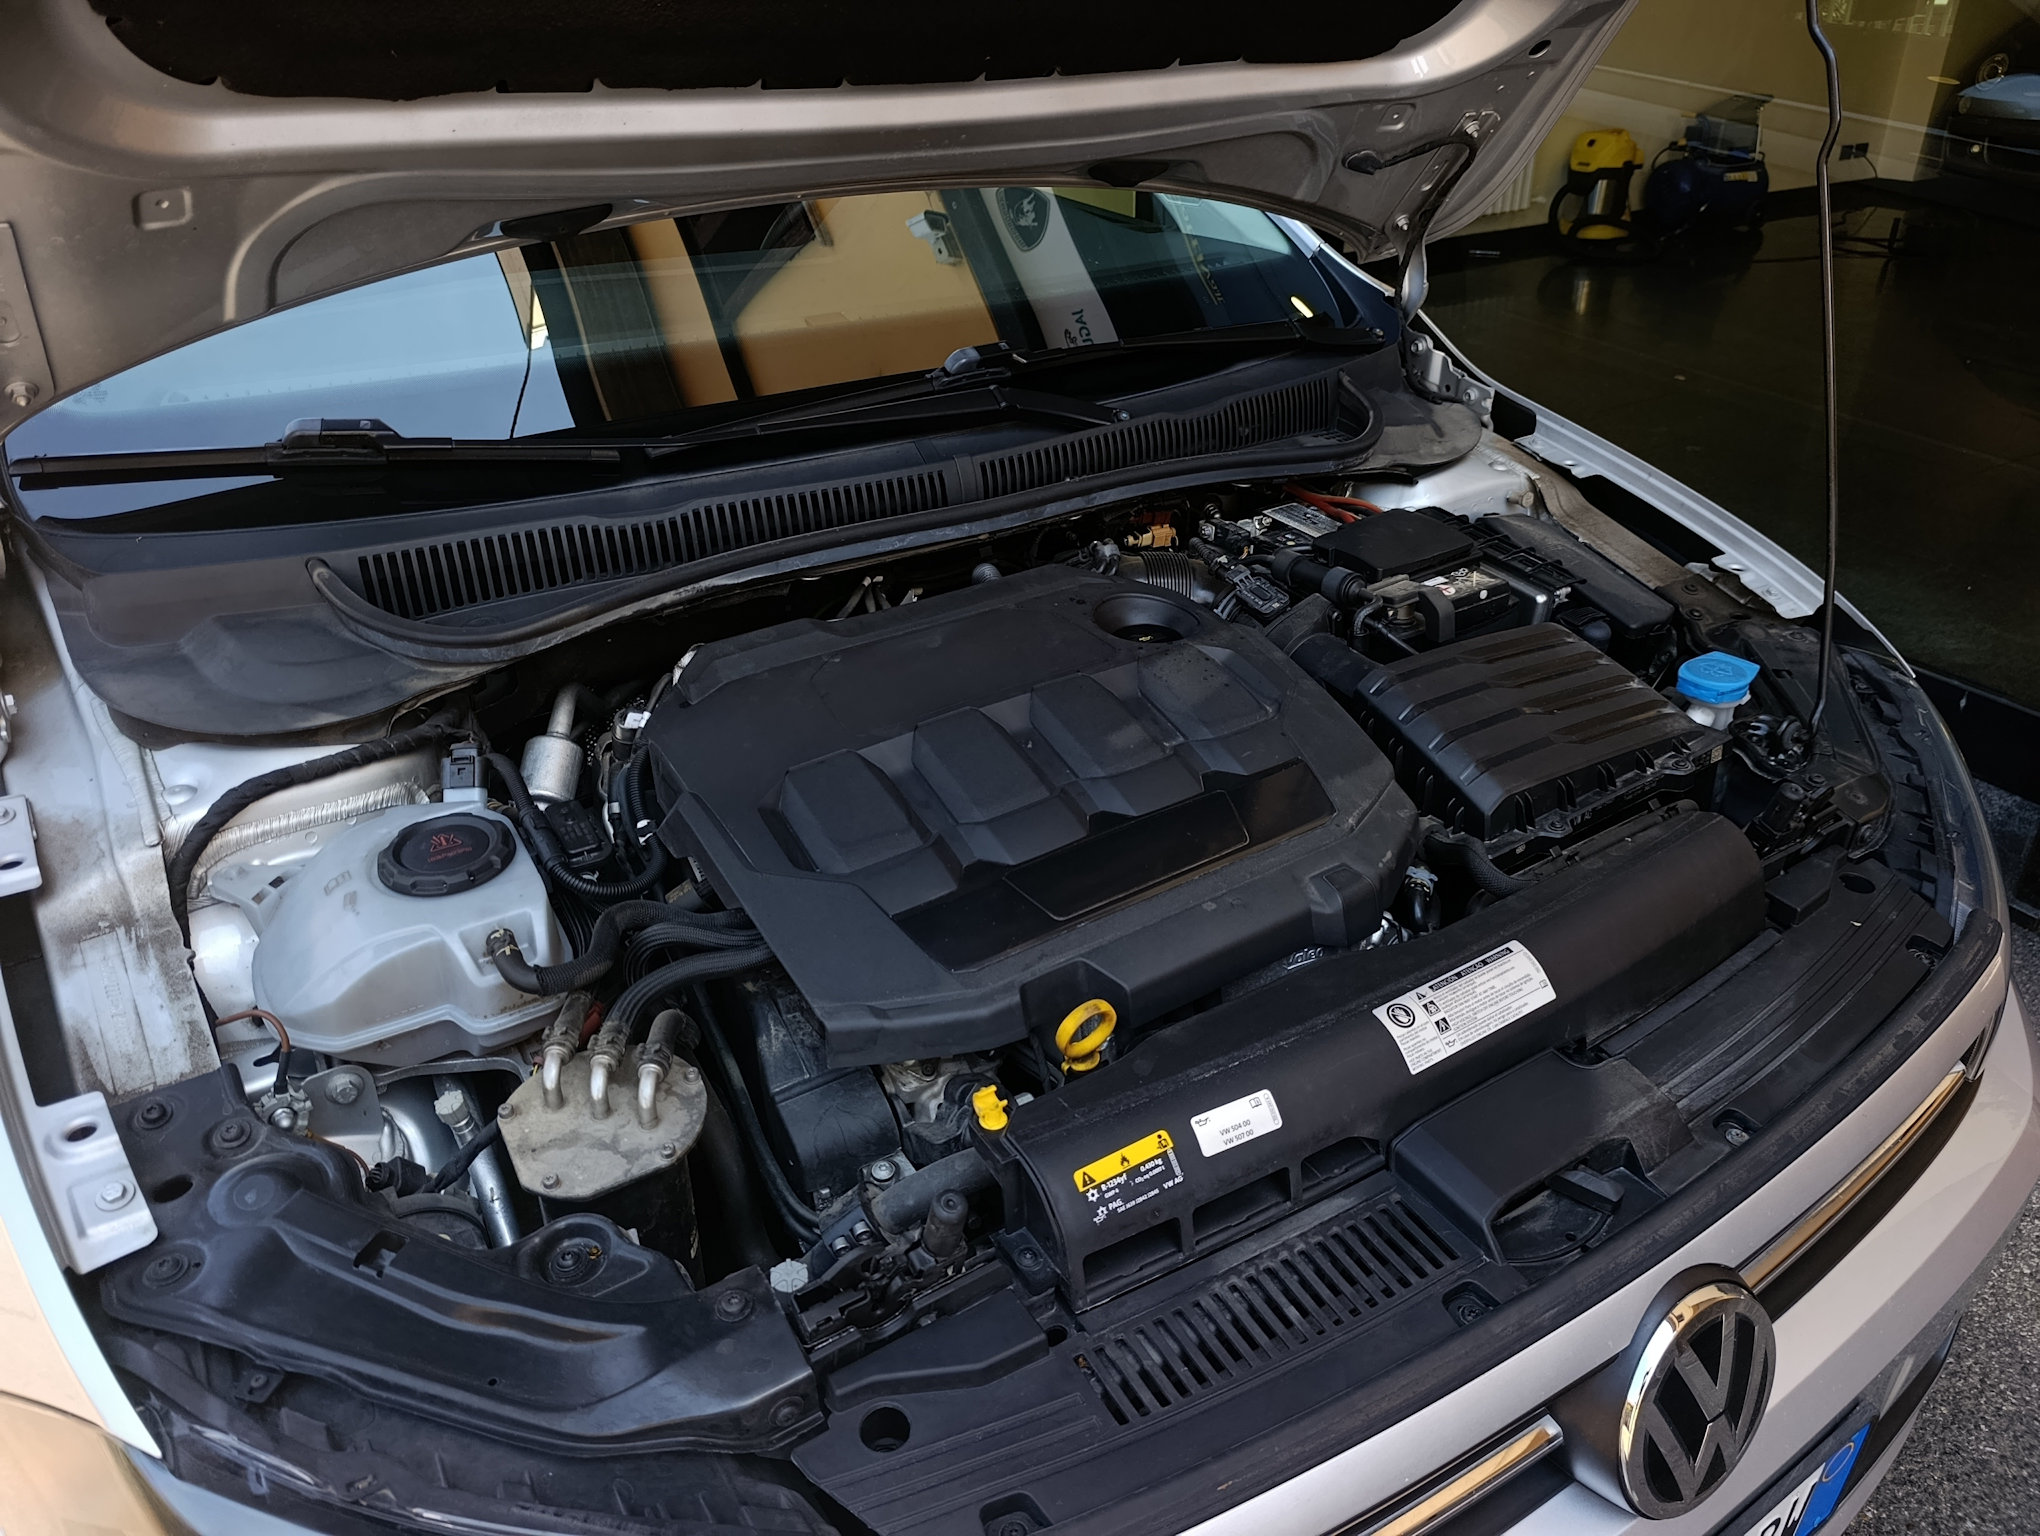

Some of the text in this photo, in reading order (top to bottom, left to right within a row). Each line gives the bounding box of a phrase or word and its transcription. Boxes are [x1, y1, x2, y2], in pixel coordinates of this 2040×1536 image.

[1485, 948, 1510, 964] WARNING
[1219, 1119, 1251, 1136] VW 504 00
[1223, 1129, 1254, 1145] VW 507 00
[1101, 1172, 1127, 1191] R-1234yf
[1162, 1175, 1184, 1189] VW AG
[1630, 1296, 1772, 1510] VW
